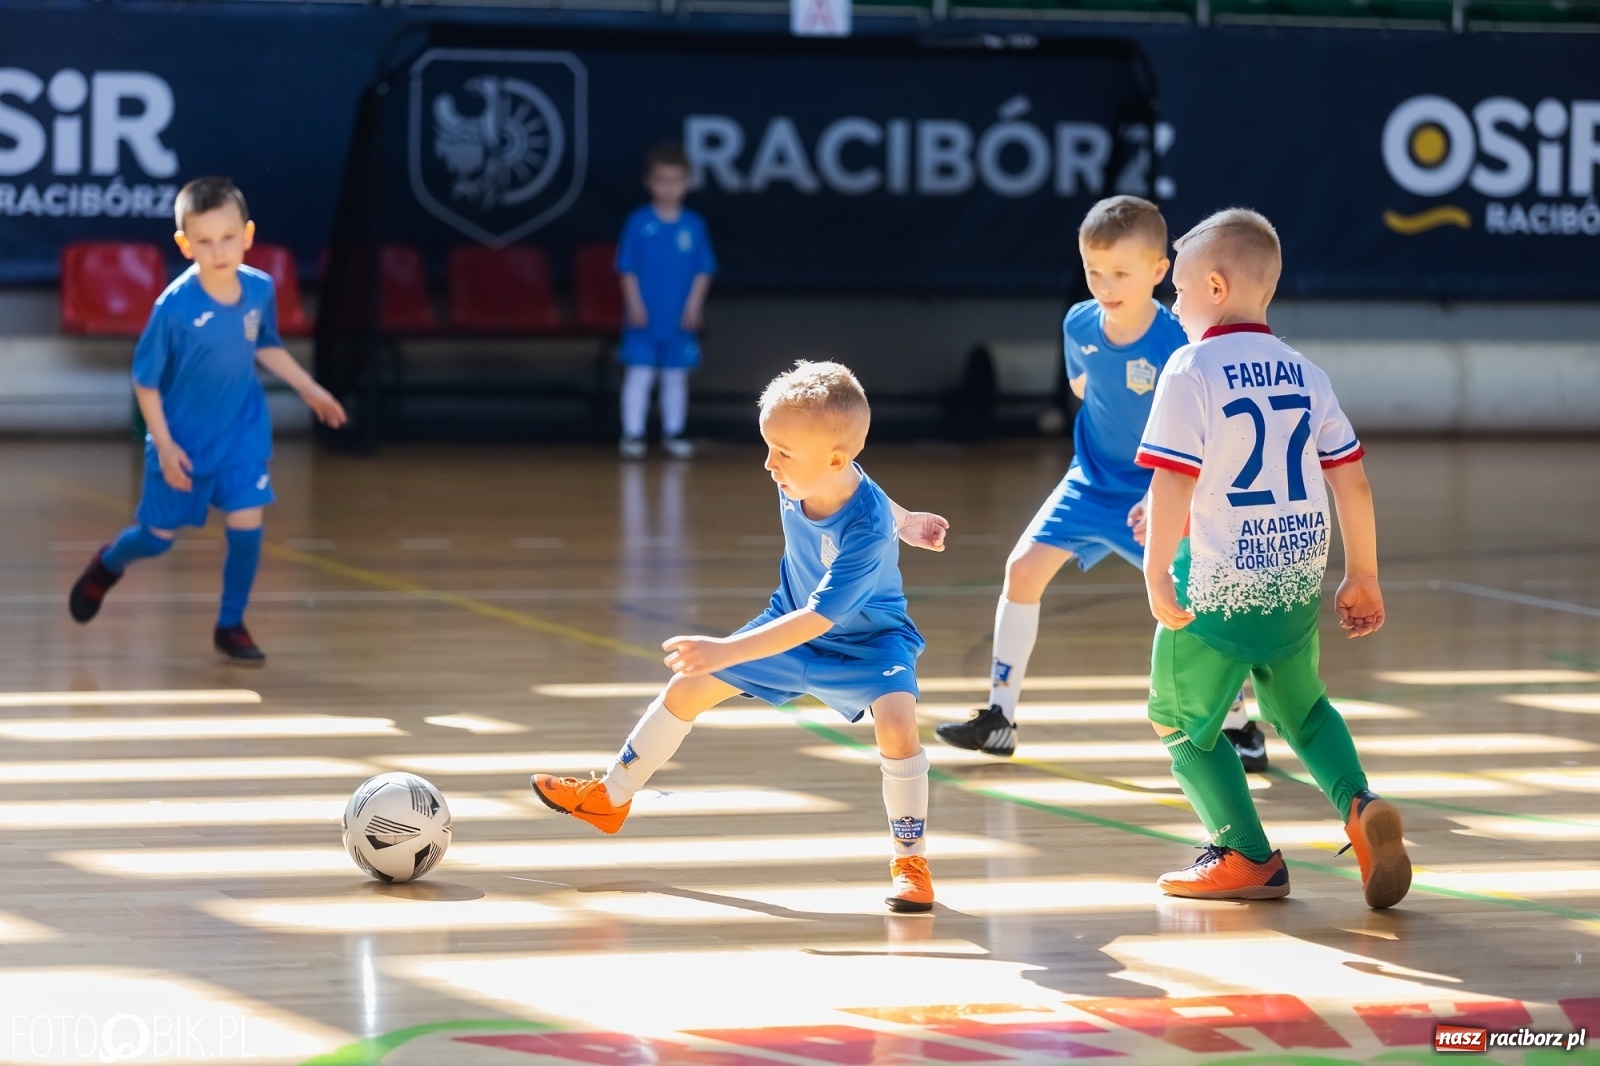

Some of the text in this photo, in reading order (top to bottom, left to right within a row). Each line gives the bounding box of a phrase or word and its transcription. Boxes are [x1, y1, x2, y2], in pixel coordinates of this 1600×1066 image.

[1223, 360, 1304, 389] FABIAN
[1222, 394, 1311, 507] 27
[1241, 511, 1325, 536] AKADEMIA
[1238, 529, 1326, 555] PIŁKARSKA
